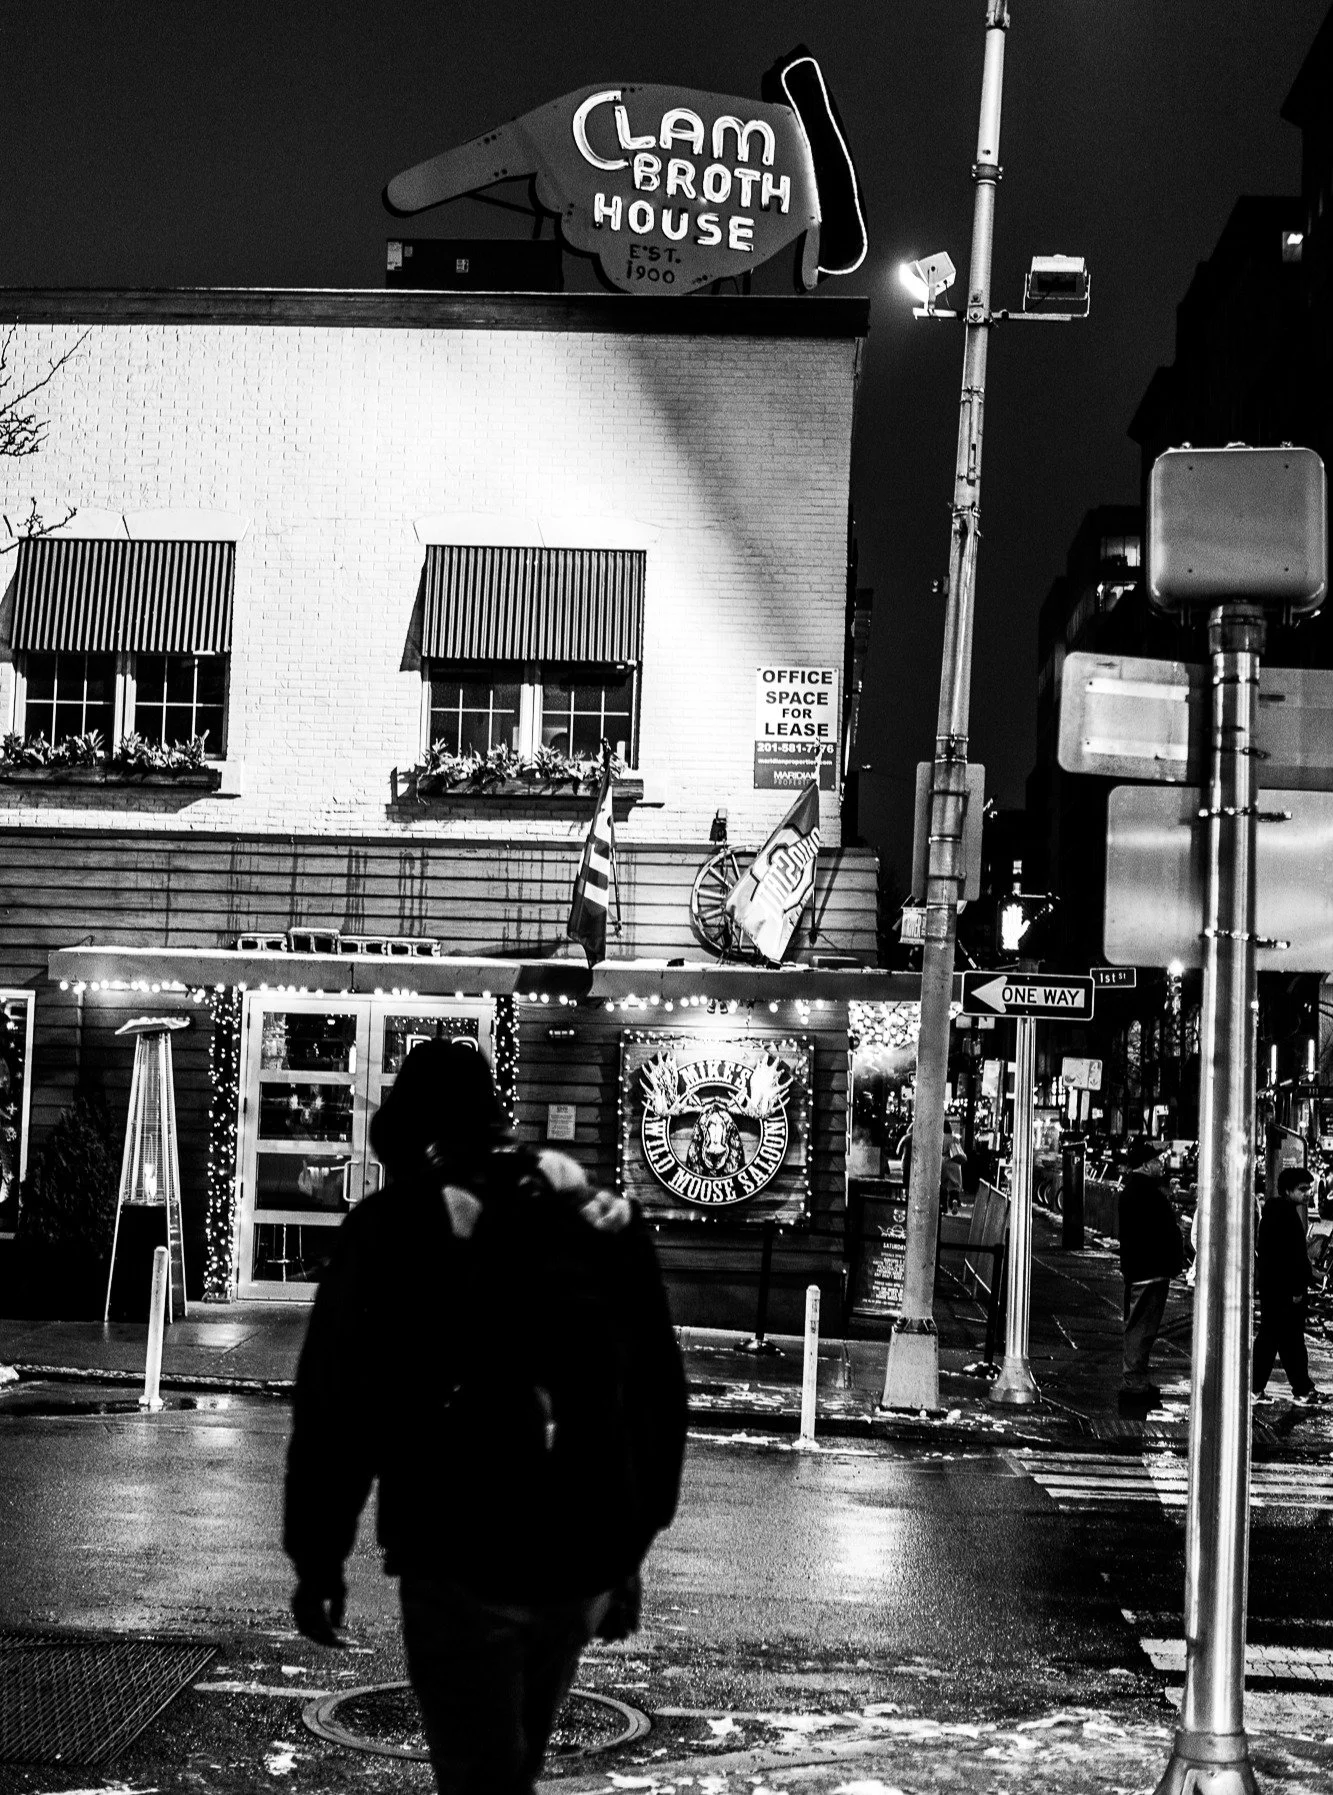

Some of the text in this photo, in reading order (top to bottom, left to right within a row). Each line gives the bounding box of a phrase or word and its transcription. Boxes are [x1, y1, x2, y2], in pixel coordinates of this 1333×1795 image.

[572, 90, 776, 171] CLAM
[632, 152, 791, 214] BROTH
[593, 193, 755, 252] HOUSE
[626, 260, 675, 284] 1900
[762, 669, 833, 685] OFFICE
[765, 691, 829, 705] SPACE
[782, 708, 812, 719] FOR
[765, 722, 829, 737] LEASE
[1100, 972, 1116, 983] 1st
[1002, 987, 1079, 1006] ONE WAY
[680, 1061, 752, 1088] MIKE'S
[644, 1119, 786, 1203] WILD MOOSE SALOON
